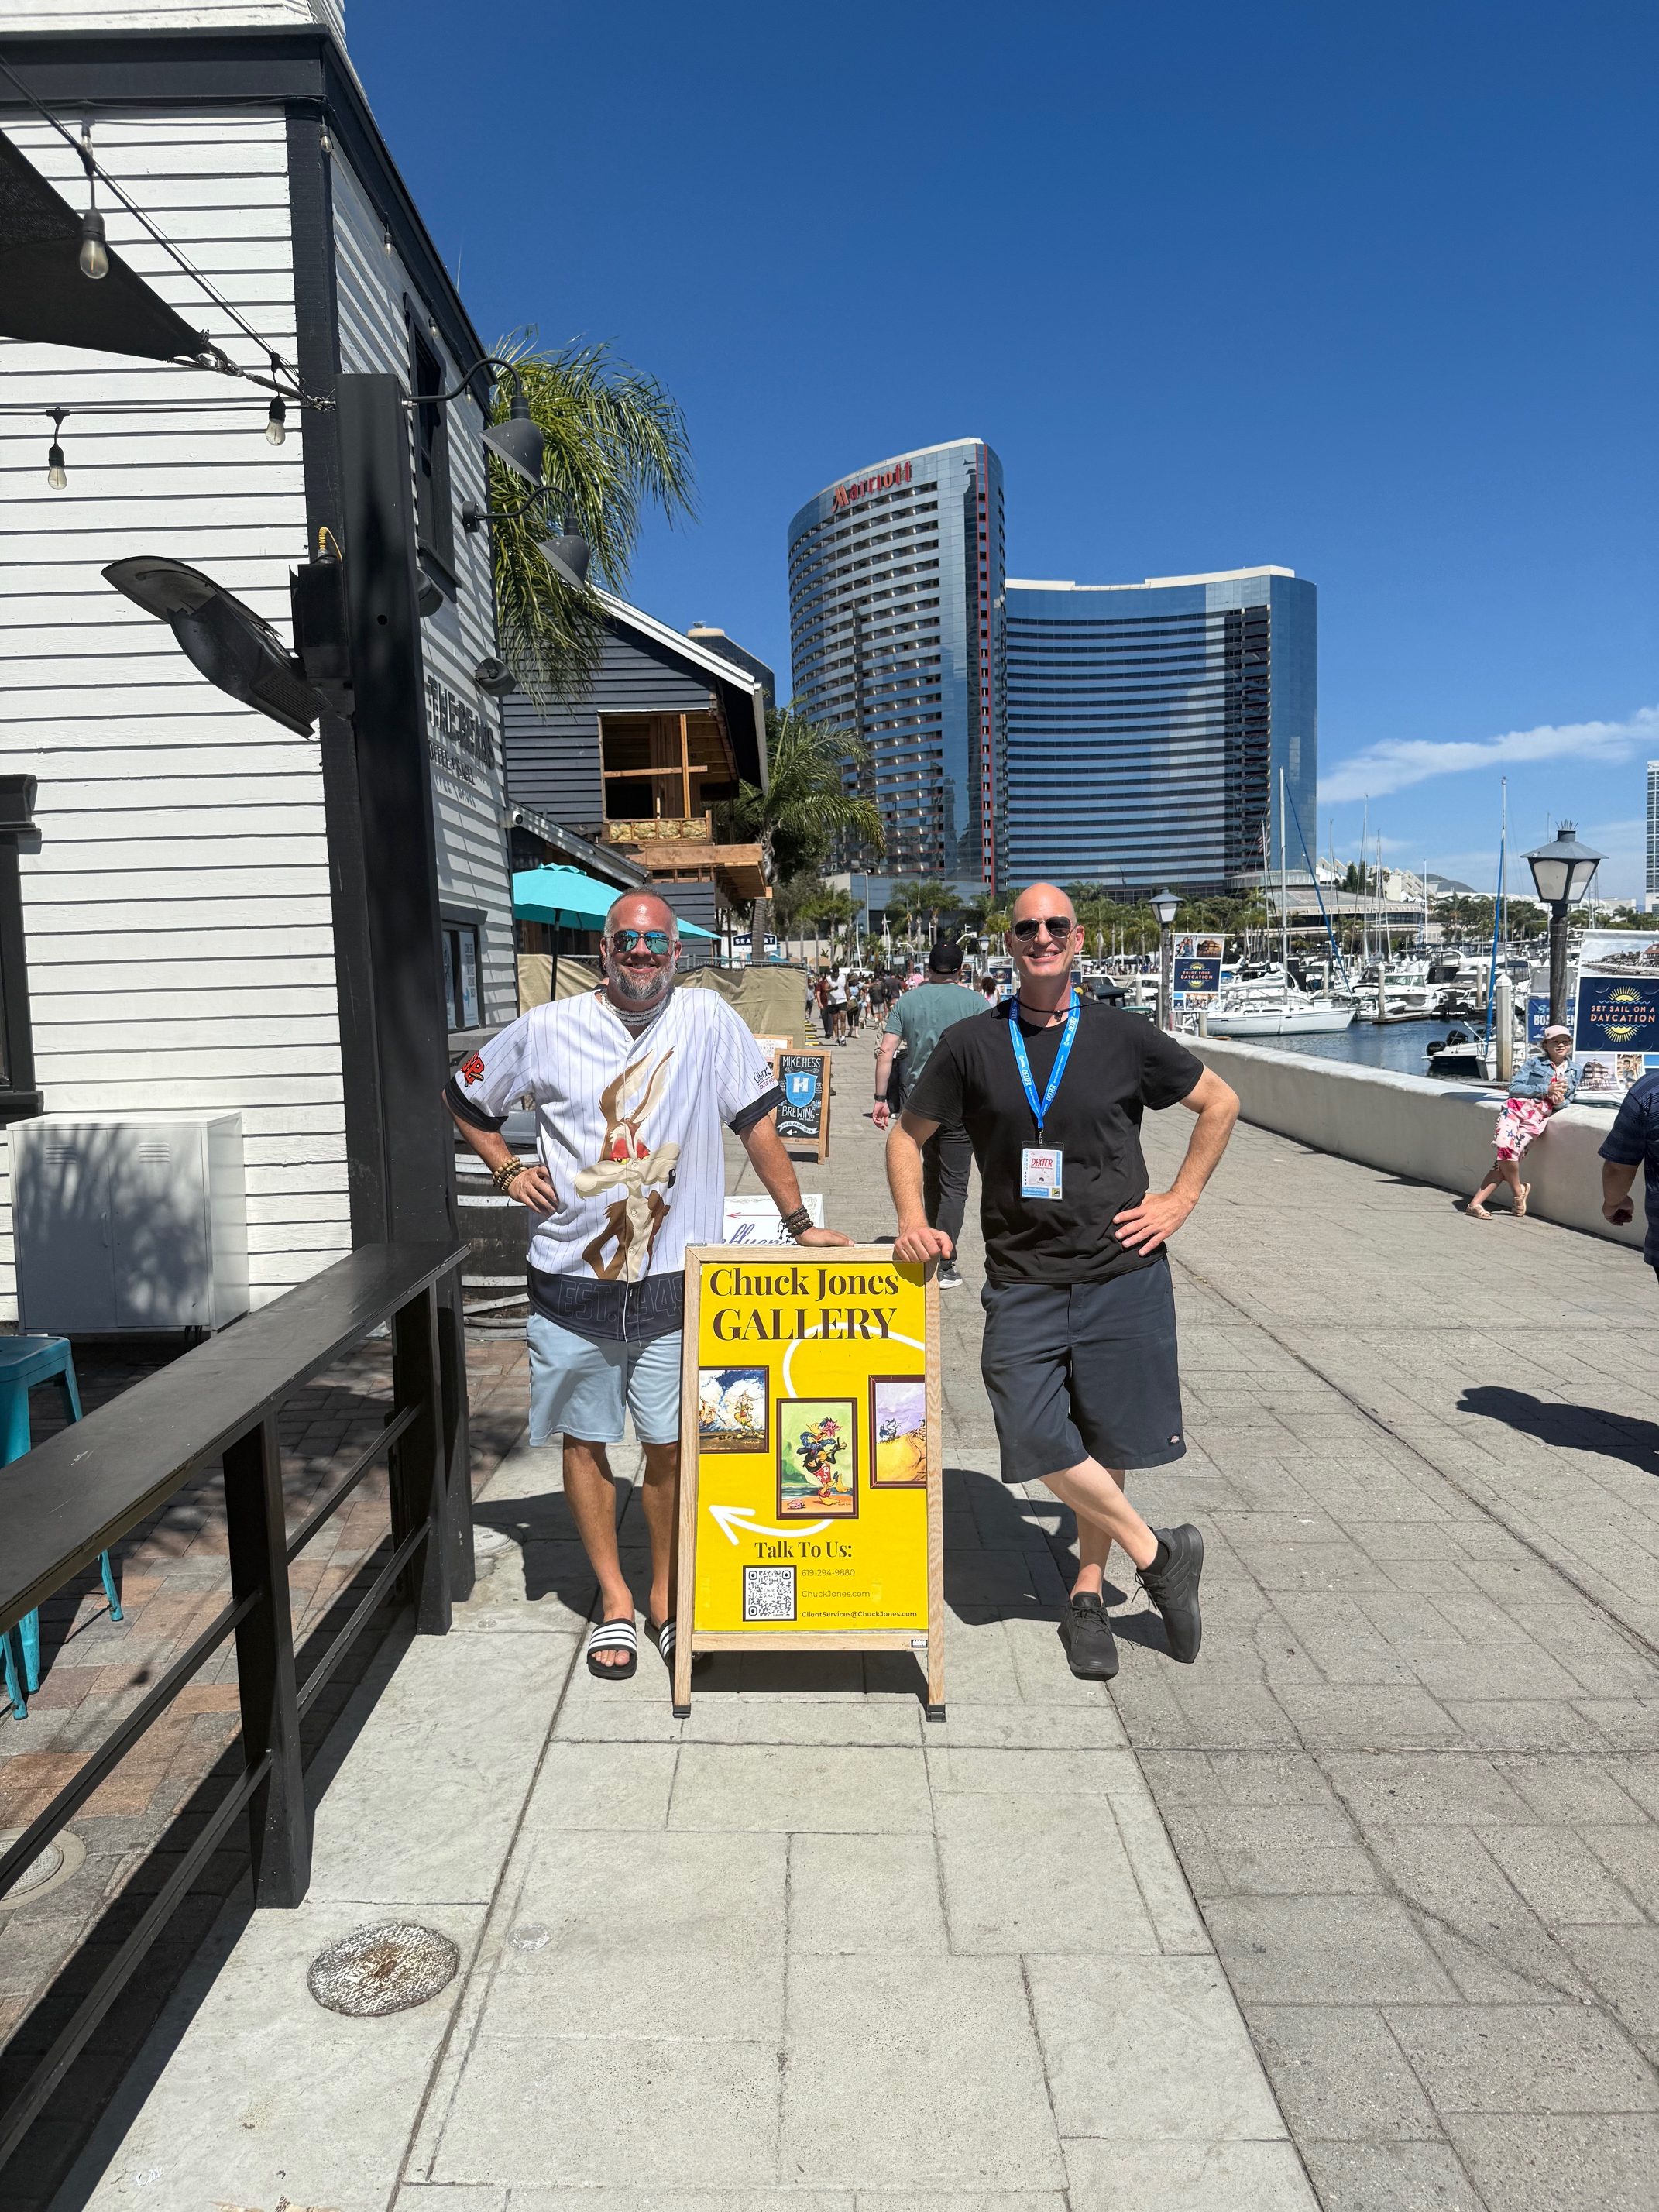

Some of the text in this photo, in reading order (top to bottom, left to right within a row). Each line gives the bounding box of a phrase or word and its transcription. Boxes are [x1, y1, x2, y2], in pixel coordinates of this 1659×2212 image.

[831, 461, 912, 512] Marriott
[1590, 1014, 1656, 1022] DAYCATION
[782, 1056, 821, 1068] MIKE HESS
[792, 1077, 809, 1093] H
[1022, 1069, 1032, 1086] DEXTER
[1046, 1084, 1056, 1101] DEXTER
[781, 1105, 816, 1119] BREWING
[1031, 1158, 1053, 1167] DEXTER
[709, 1266, 899, 1301] Chuck Jones
[713, 1307, 898, 1341] GALLERY
[754, 1541, 852, 1558] Talk To Us:
[802, 1568, 856, 1577] 619-294-9880
[802, 1589, 871, 1599] ChuckJones.com
[802, 1610, 917, 1619] ClientServices@ChuckJones.com
